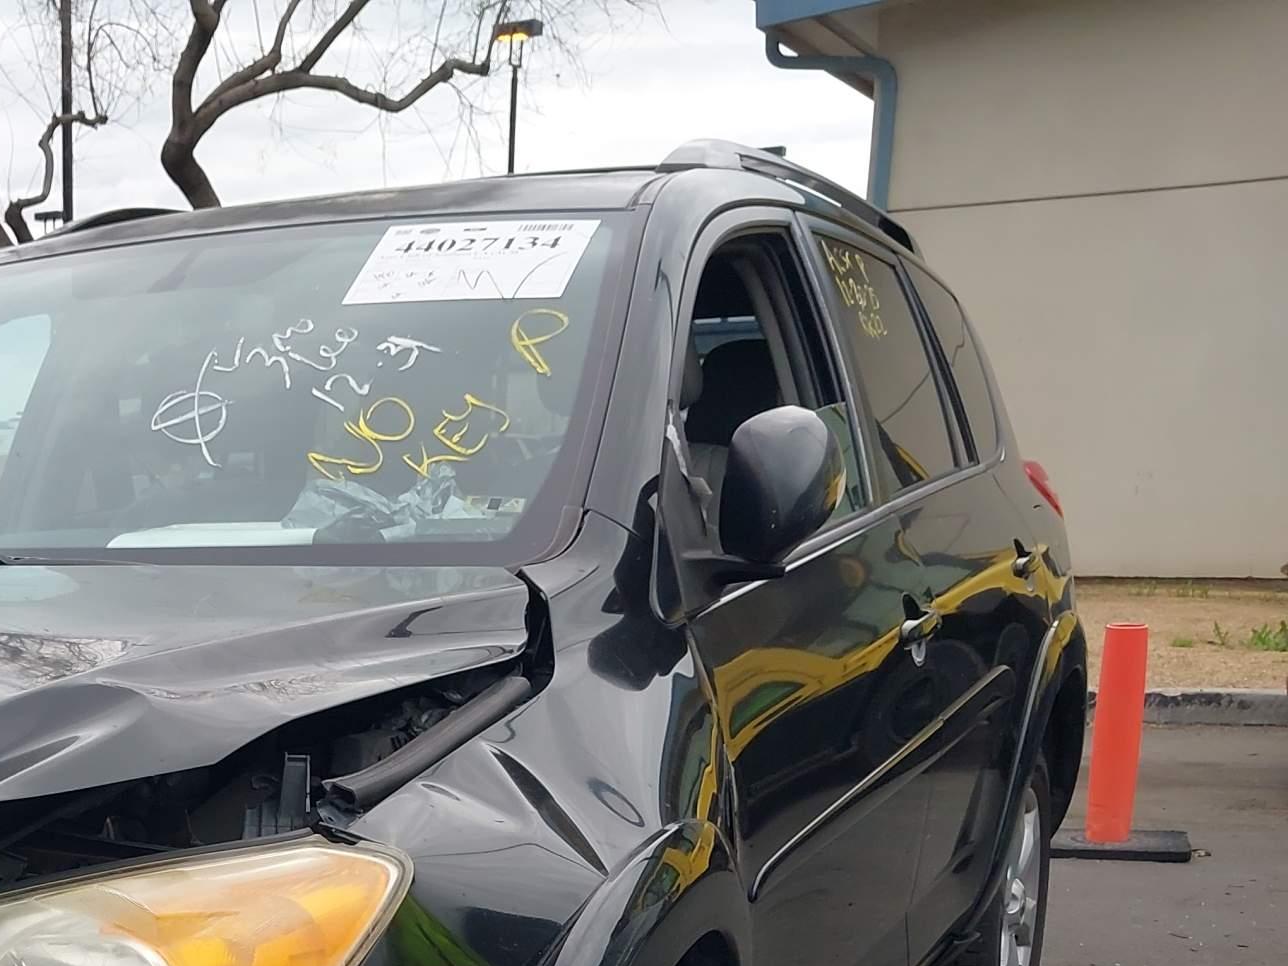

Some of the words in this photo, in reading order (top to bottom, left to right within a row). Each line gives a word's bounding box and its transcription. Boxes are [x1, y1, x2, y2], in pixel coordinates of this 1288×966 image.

[394, 235, 563, 254] 44027134
[308, 397, 415, 482] NO
[403, 394, 510, 479] KEY
